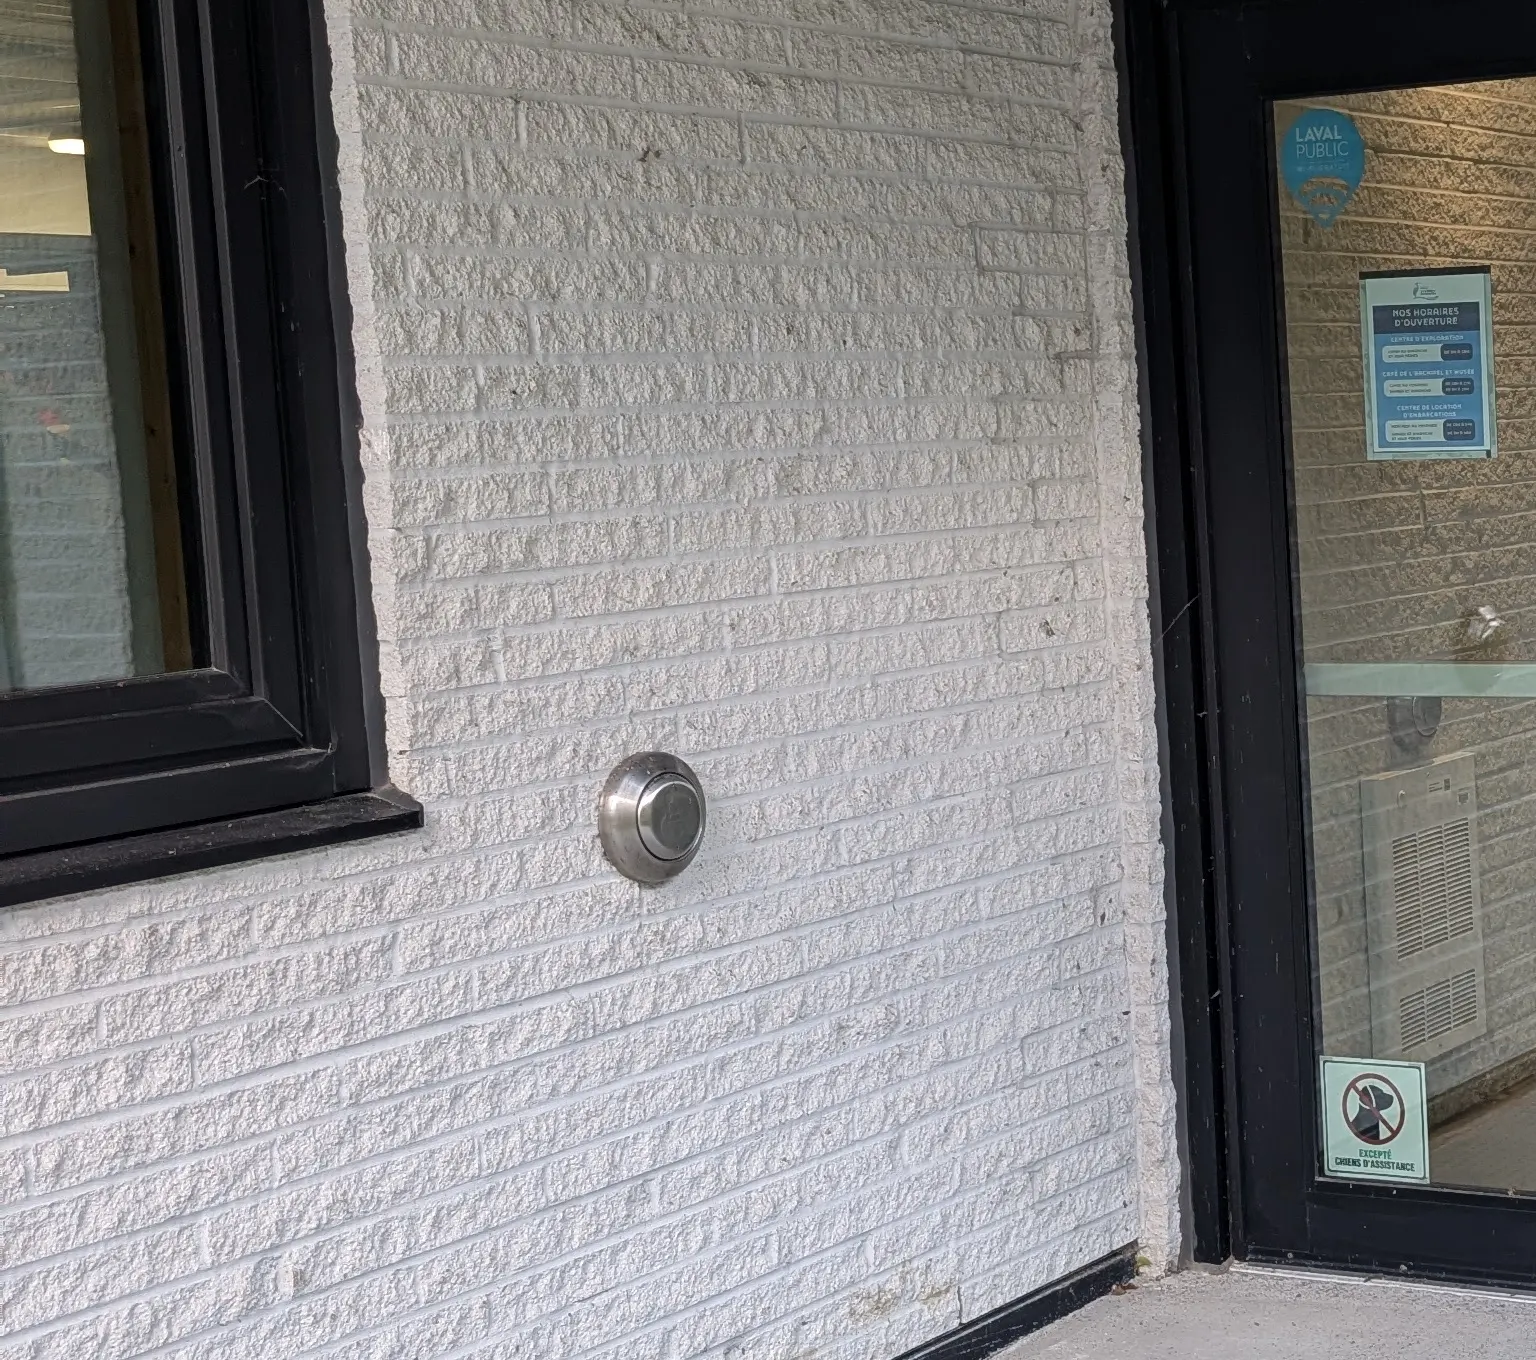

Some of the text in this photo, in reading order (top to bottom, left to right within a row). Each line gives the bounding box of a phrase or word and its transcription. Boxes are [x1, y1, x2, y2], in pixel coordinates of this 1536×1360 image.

[1295, 125, 1342, 142] LAVAL
[1296, 141, 1349, 159] PUBLIC
[1392, 307, 1460, 317] NOS HORAIRES
[1394, 317, 1458, 327] D'OUVERTURE
[1359, 1148, 1392, 1160] EXCEPTÉ
[1335, 1156, 1415, 1172] CHIENS D'ASSISTANCE
